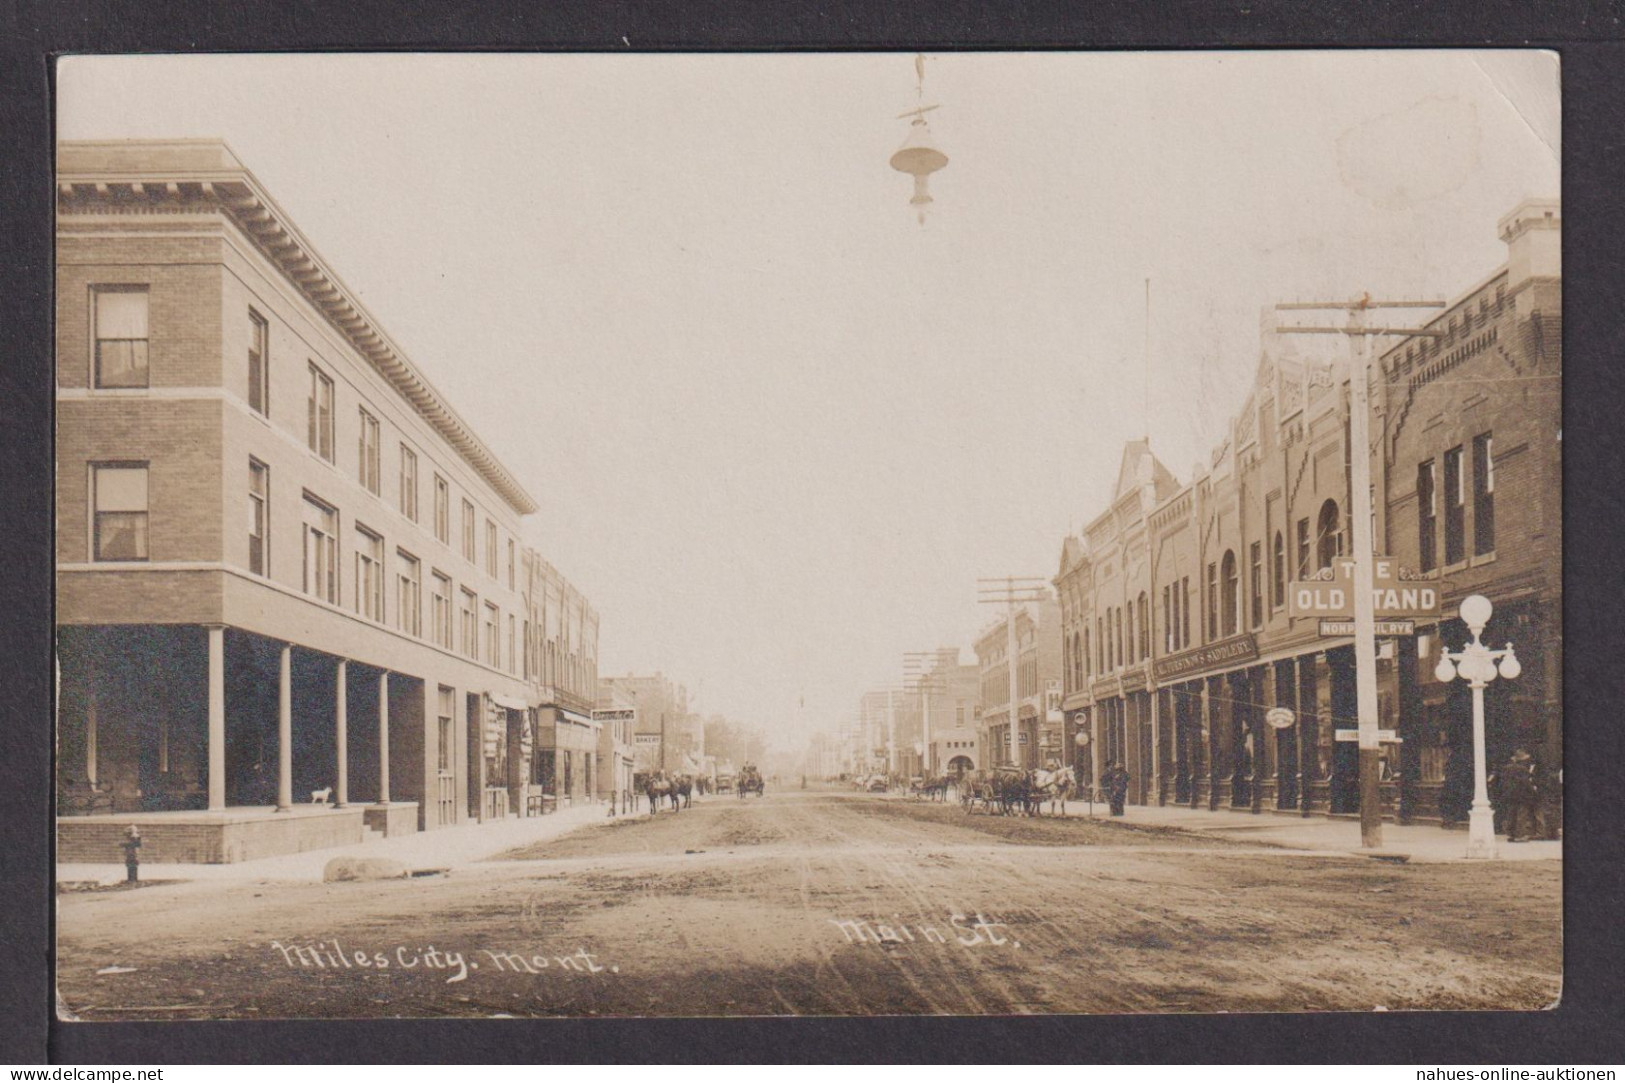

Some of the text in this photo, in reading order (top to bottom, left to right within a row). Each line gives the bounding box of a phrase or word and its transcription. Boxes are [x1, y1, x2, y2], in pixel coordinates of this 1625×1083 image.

[1341, 561, 1391, 579] TE
[1297, 588, 1436, 610] OLD TAND
[1389, 621, 1413, 634] RYE
[827, 913, 1021, 949] Main St.
[272, 939, 390, 969] Miles
[483, 947, 620, 975] Mont.
